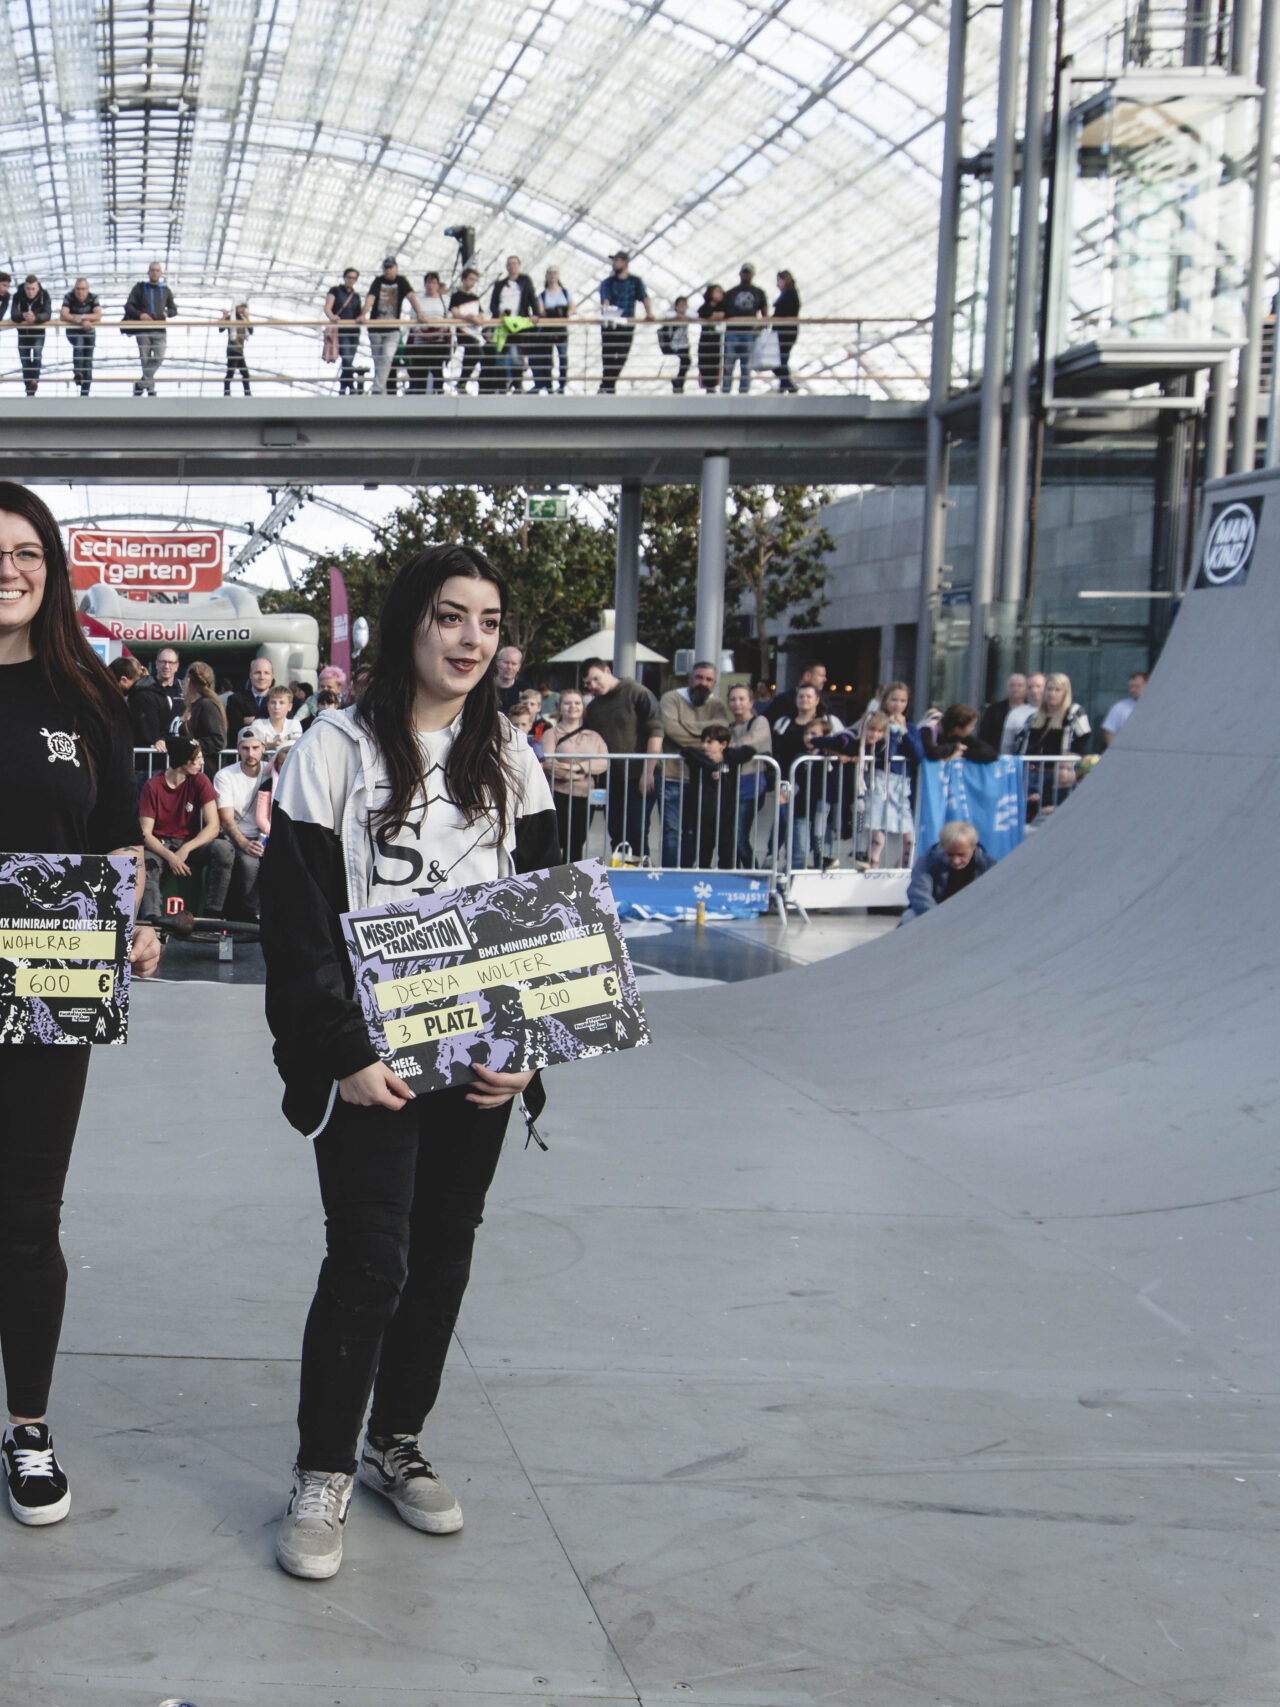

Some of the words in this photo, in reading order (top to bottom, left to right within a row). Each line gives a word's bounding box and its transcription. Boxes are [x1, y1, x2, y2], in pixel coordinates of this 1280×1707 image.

[108, 562, 187, 583] garten
[191, 624, 251, 641] Arena
[52, 739, 72, 754] TSG
[12, 918, 61, 929] MINIRAMP
[62, 919, 103, 930] CONTEST
[105, 920, 117, 931] 22
[2, 935, 81, 951] WOHLRAB
[478, 945, 500, 959] BMX
[500, 934, 550, 955] MINIRAMP
[550, 924, 591, 944] CONTEST
[591, 922, 605, 934] 22
[29, 974, 70, 994] 600
[98, 974, 110, 993] €
[391, 974, 460, 1004] DERYA
[476, 953, 551, 985] WOLTER
[534, 989, 571, 1011] 200
[602, 977, 617, 997] €
[398, 1024, 412, 1044] 3
[423, 1007, 478, 1037] PLATZ
[391, 1056, 417, 1070] HEIZ
[394, 1064, 423, 1079] HAUS
